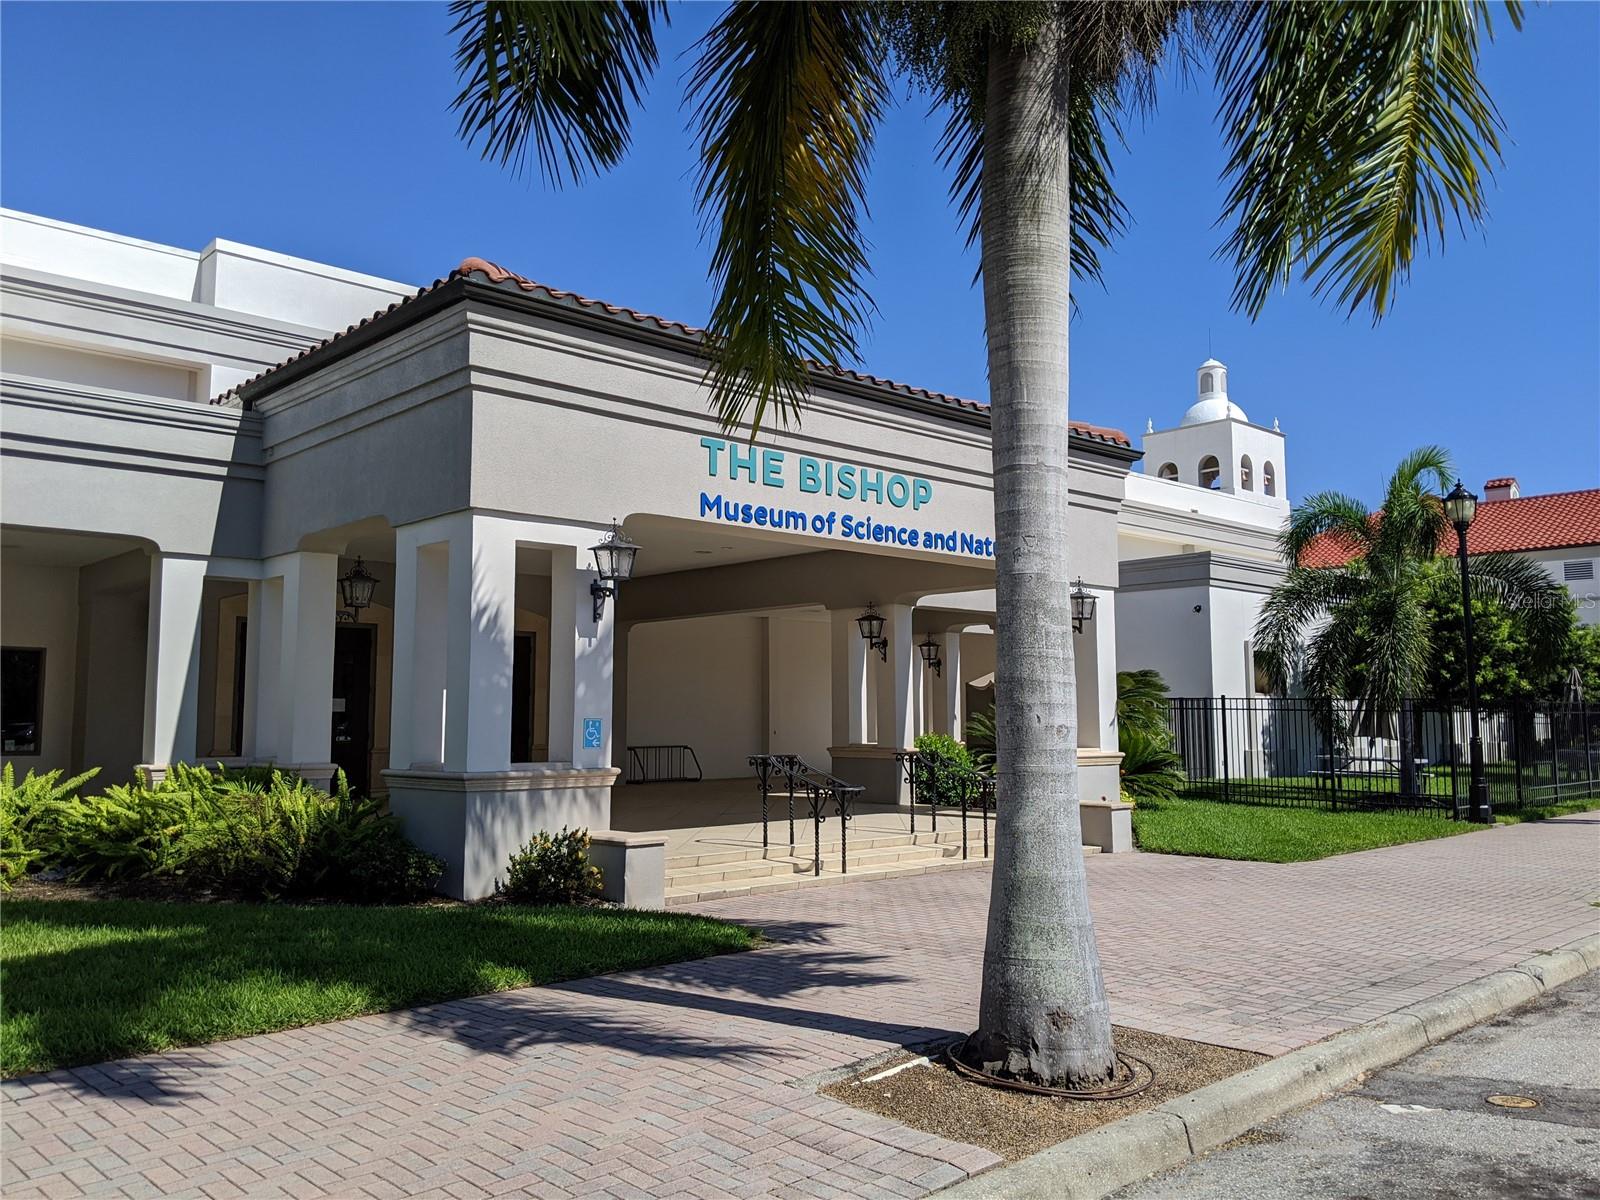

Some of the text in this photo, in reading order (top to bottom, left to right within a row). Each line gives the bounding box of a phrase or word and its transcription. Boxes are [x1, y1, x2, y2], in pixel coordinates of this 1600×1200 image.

[700, 437, 933, 511] THE BISHOP
[700, 492, 807, 531] Museum
[811, 511, 836, 535] of
[841, 514, 919, 547] Science
[922, 530, 957, 552] and
